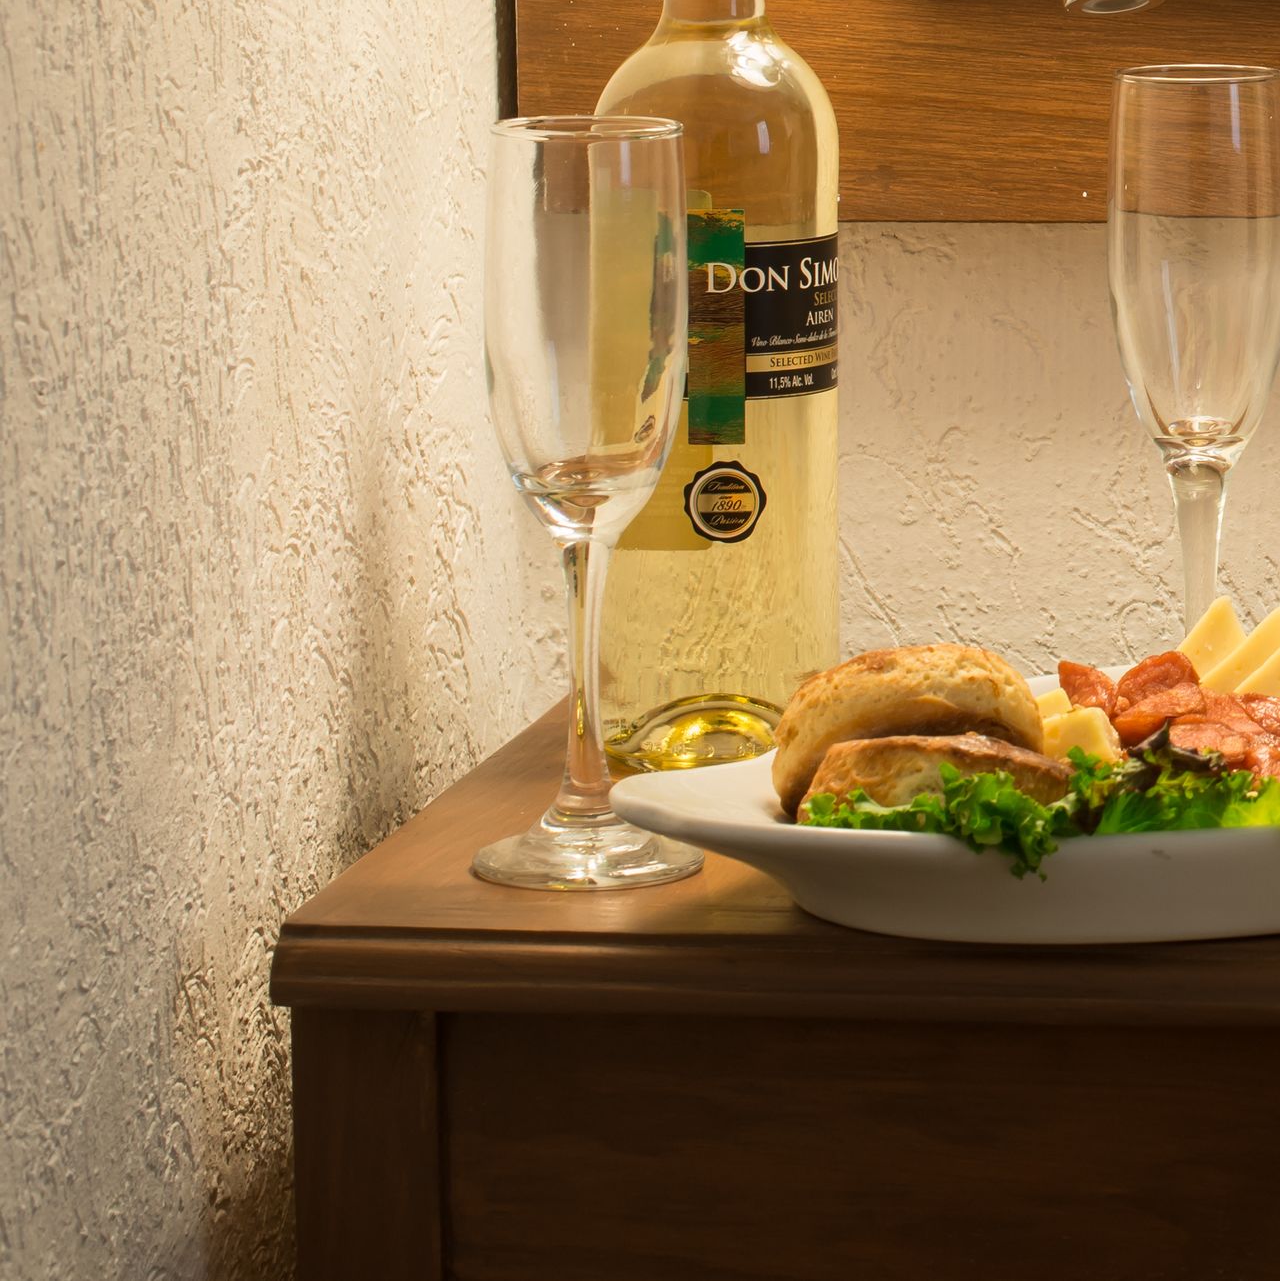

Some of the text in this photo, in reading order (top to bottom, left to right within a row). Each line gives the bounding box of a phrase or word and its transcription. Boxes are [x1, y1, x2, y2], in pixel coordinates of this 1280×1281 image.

[704, 262, 791, 294] DON
[806, 308, 834, 327] AIREN
[769, 354, 814, 368] SELECTED
[769, 376, 791, 391] 11,5%
[711, 499, 742, 511] 1890
